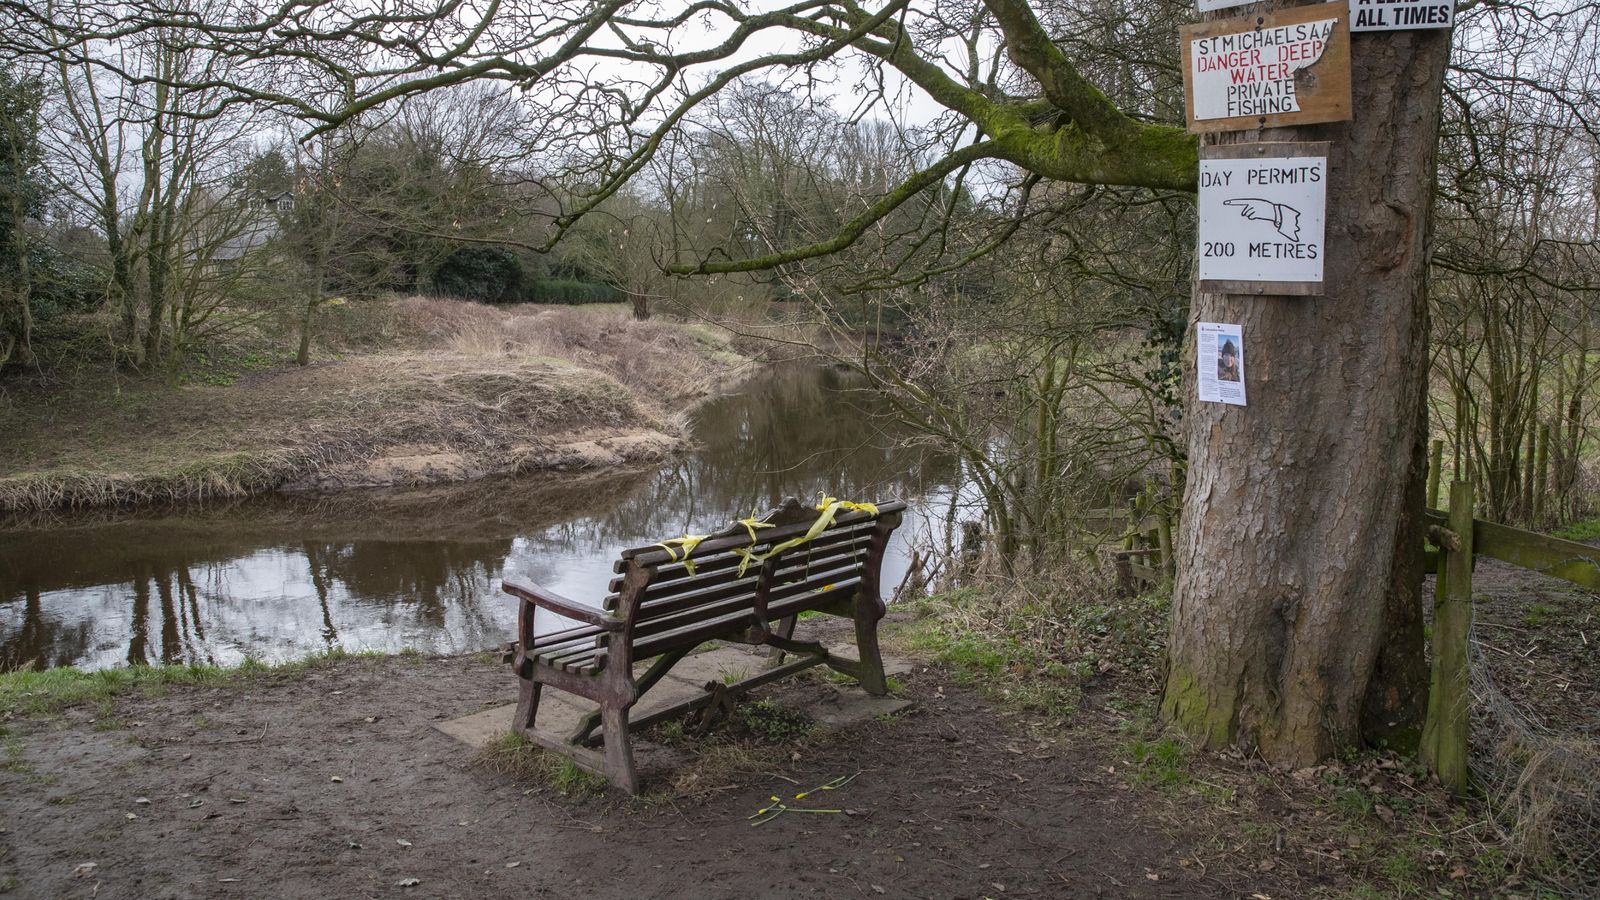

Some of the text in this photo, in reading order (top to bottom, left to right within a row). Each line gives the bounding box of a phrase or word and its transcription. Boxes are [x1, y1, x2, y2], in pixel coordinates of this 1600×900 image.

[1355, 5, 1449, 27] ALL TIMES
[1197, 40, 1323, 72] DANGER DEEP
[1230, 62, 1290, 84] WATER
[1227, 79, 1295, 101] PRIVATE
[1227, 96, 1292, 116] FISHING
[1201, 167, 1321, 187] DAY PERMITS
[1204, 242, 1318, 259] 200 METRES
